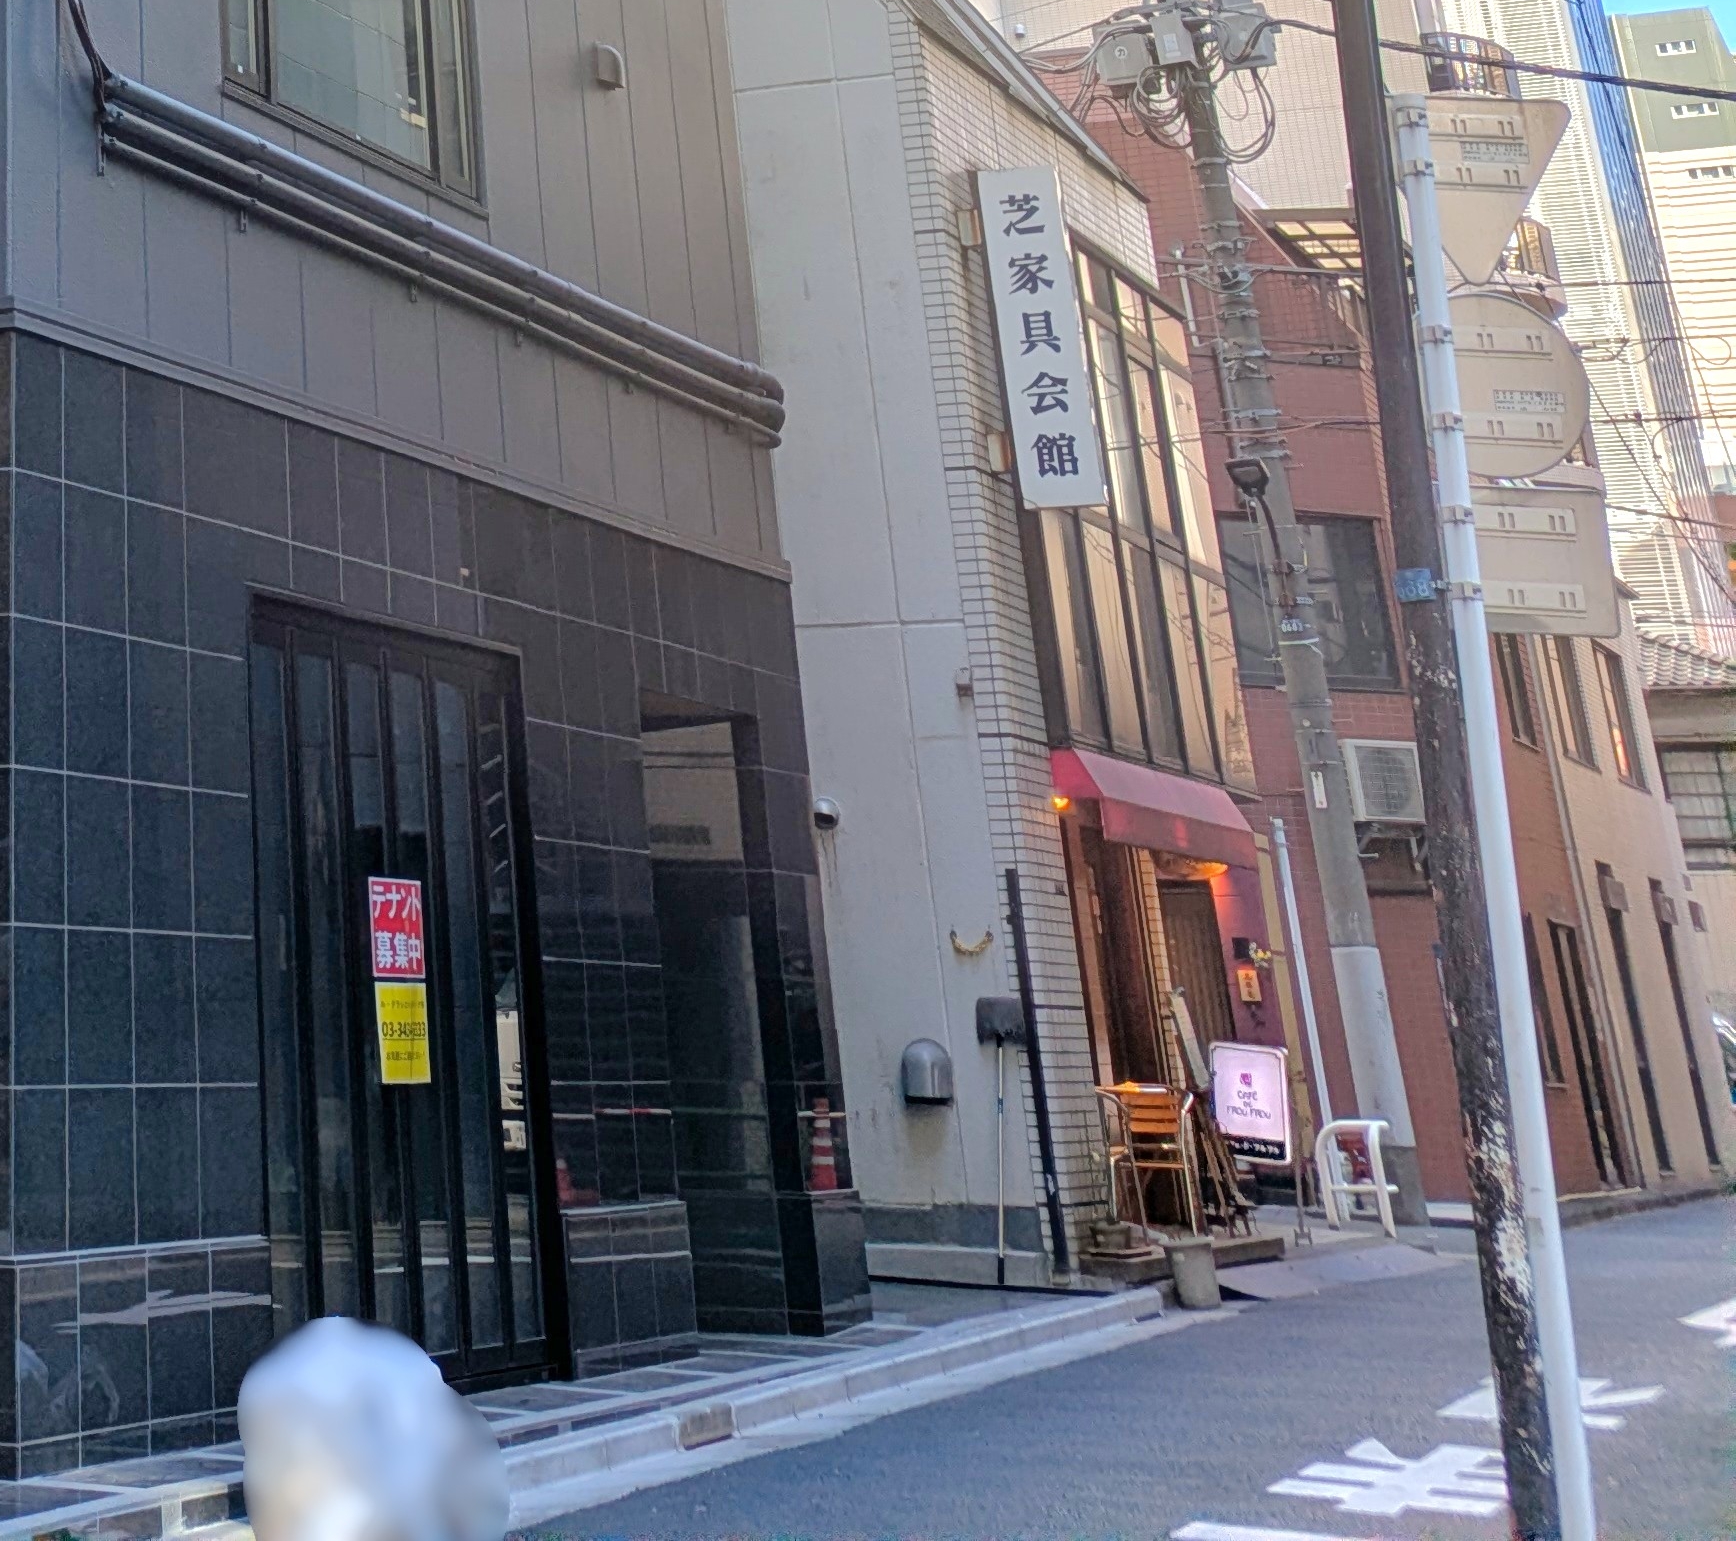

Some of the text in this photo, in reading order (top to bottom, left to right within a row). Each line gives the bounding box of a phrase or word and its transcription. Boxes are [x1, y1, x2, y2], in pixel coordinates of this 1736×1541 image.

[999, 193, 1080, 478] 芝家具会館
[372, 884, 422, 921] テナント
[375, 930, 421, 970] 募集中
